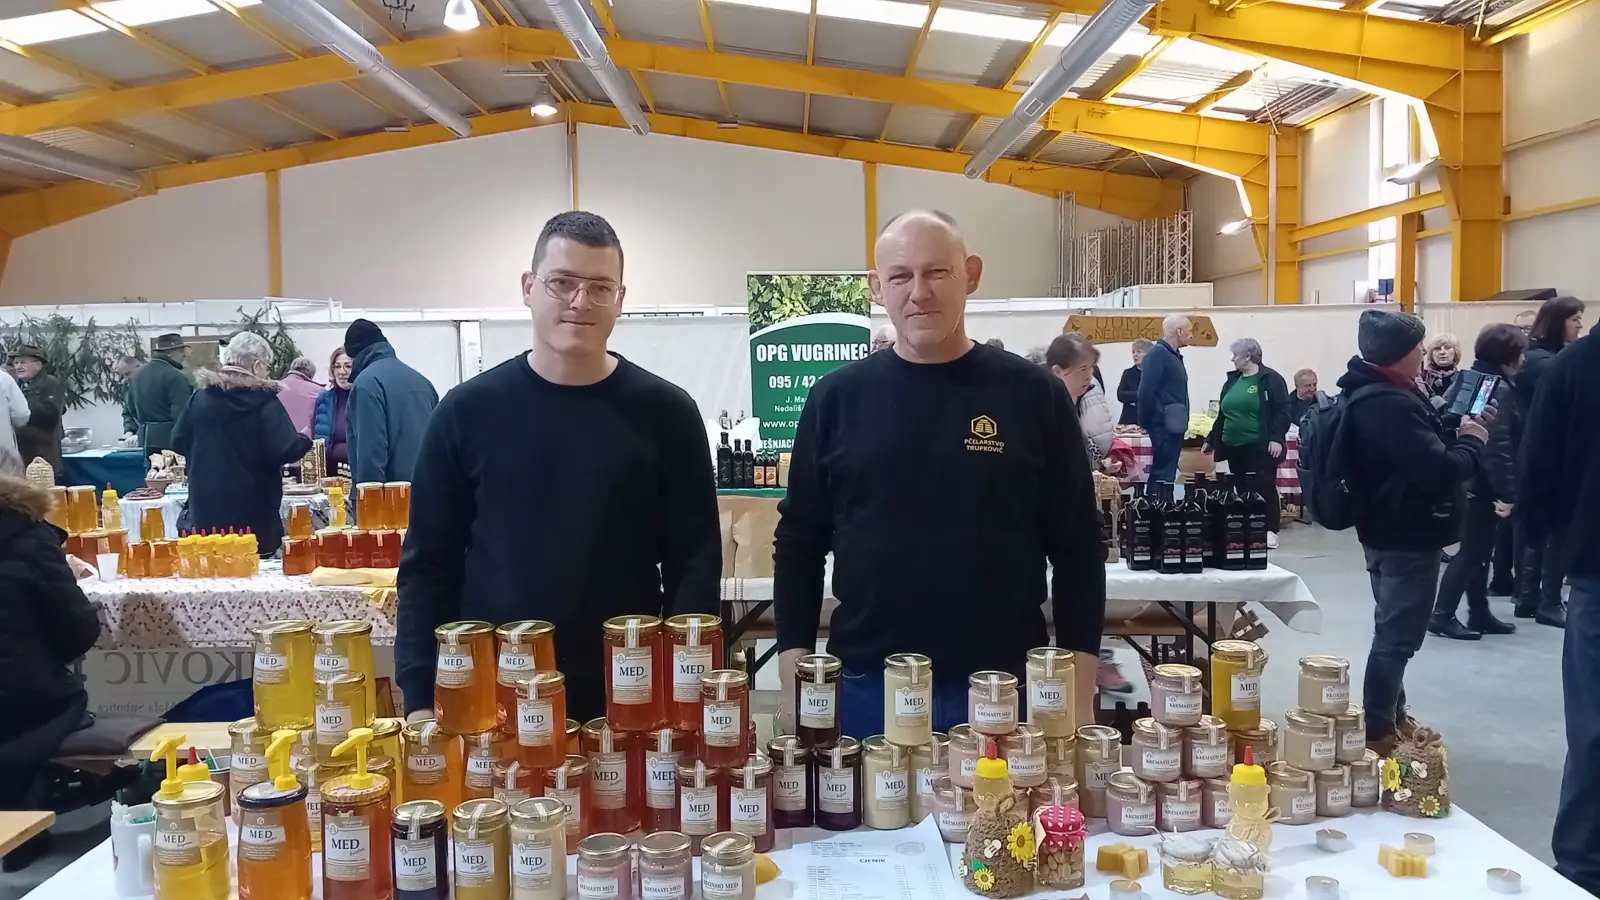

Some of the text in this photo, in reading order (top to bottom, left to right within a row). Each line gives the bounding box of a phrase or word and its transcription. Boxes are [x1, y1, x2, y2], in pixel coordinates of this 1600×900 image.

[756, 343, 869, 362] OPG VUGRINEC
[769, 376, 824, 389] 095 / 42
[259, 657, 277, 665] MED
[319, 658, 339, 666] MED
[443, 658, 463, 666] MED
[505, 657, 525, 666] MED
[620, 666, 644, 677] MED
[680, 664, 705, 674] MED
[1239, 683, 1258, 691] MED
[1039, 690, 1060, 700] MED
[808, 698, 828, 707] MED
[904, 697, 924, 706] MED
[321, 716, 341, 725] MED
[523, 715, 544, 724] MED
[711, 716, 732, 725] MED
[238, 757, 257, 765] MED
[415, 759, 436, 767] MED
[594, 770, 619, 781] MED
[652, 770, 676, 781] MED
[1095, 772, 1110, 781] ME
[778, 781, 798, 789] MED
[826, 783, 846, 792] MED
[885, 781, 904, 790] MED
[689, 803, 710, 813] MED
[739, 803, 760, 813] MED
[163, 834, 186, 843] MED
[249, 830, 272, 839] MED
[331, 838, 360, 850] MED
[403, 857, 427, 867] MED
[462, 855, 484, 864] MED
[520, 856, 543, 866] MED
[669, 884, 681, 892] MED
